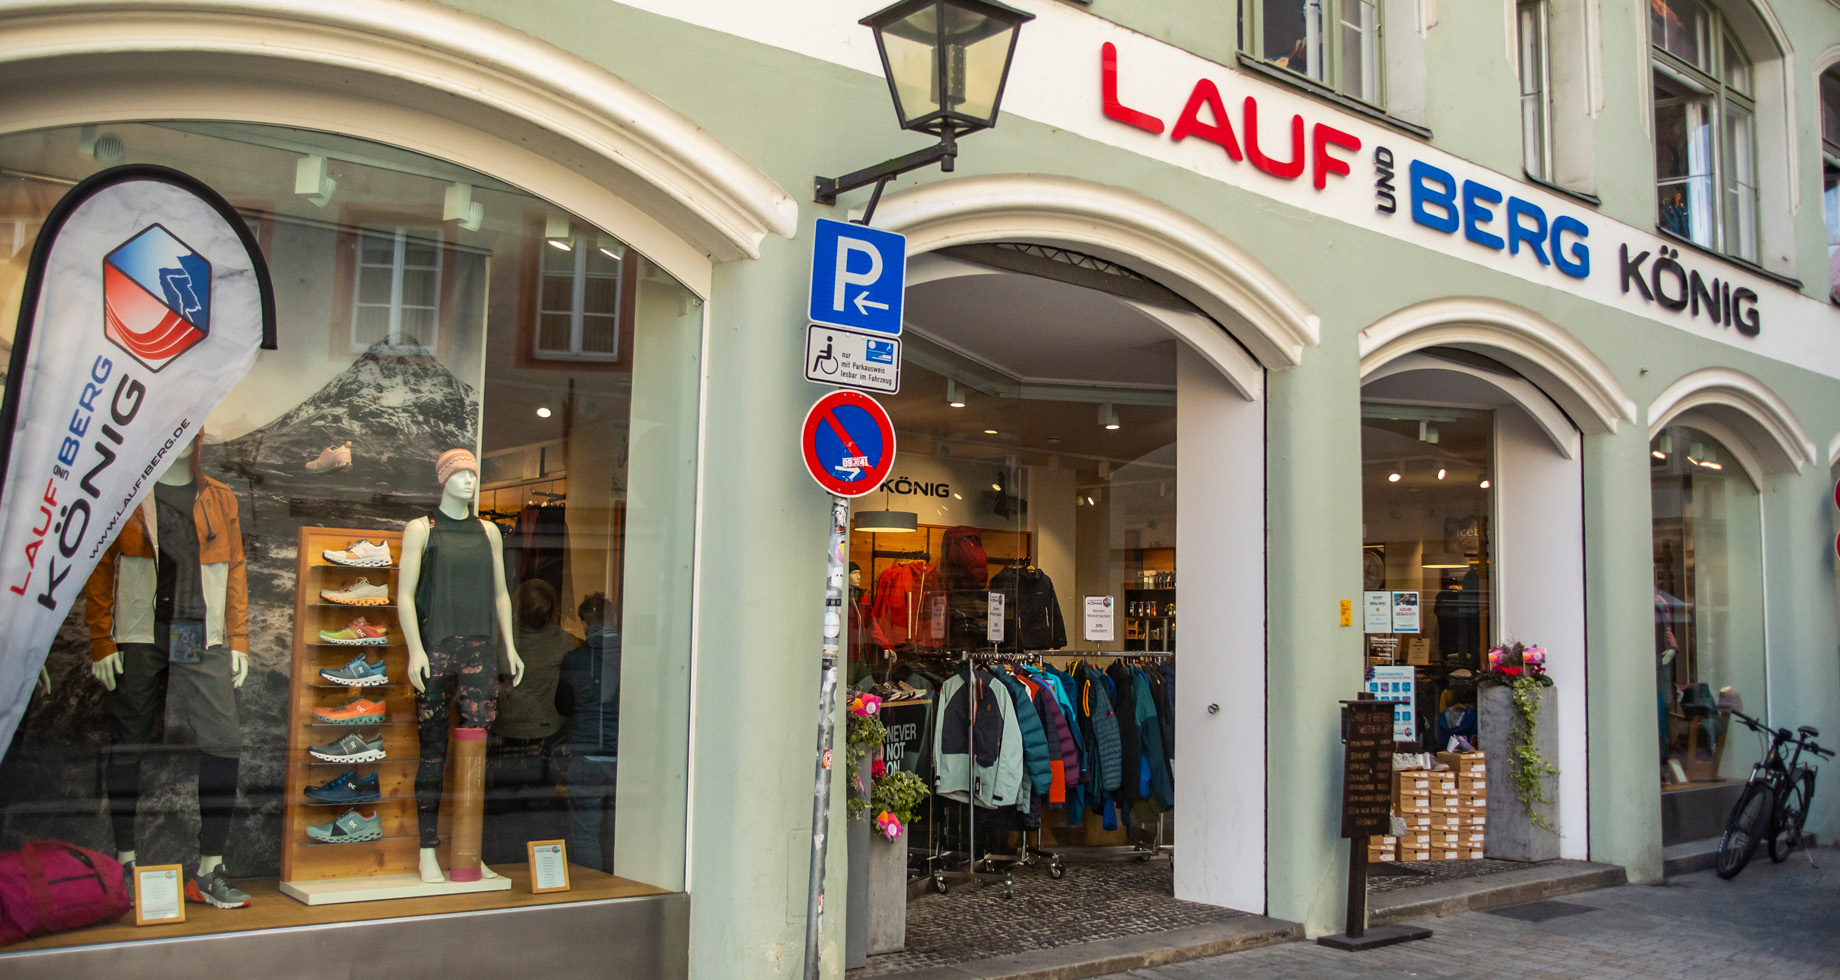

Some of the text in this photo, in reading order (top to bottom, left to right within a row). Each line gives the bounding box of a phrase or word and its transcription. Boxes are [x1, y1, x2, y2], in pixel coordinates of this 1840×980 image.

[1101, 41, 1760, 338] LAUF UND BERG KÖNIG
[833, 235, 883, 312] P
[840, 369, 858, 379] lesbar
[868, 374, 893, 387] Fahrzeug
[841, 361, 886, 374] mit Parkausweis
[10, 477, 58, 597] LAUF
[57, 354, 114, 467] BERG
[37, 372, 147, 612] KÖNIG
[879, 476, 950, 498] KÖNIG
[886, 723, 916, 742] NEVER
[886, 742, 906, 761] NOT
